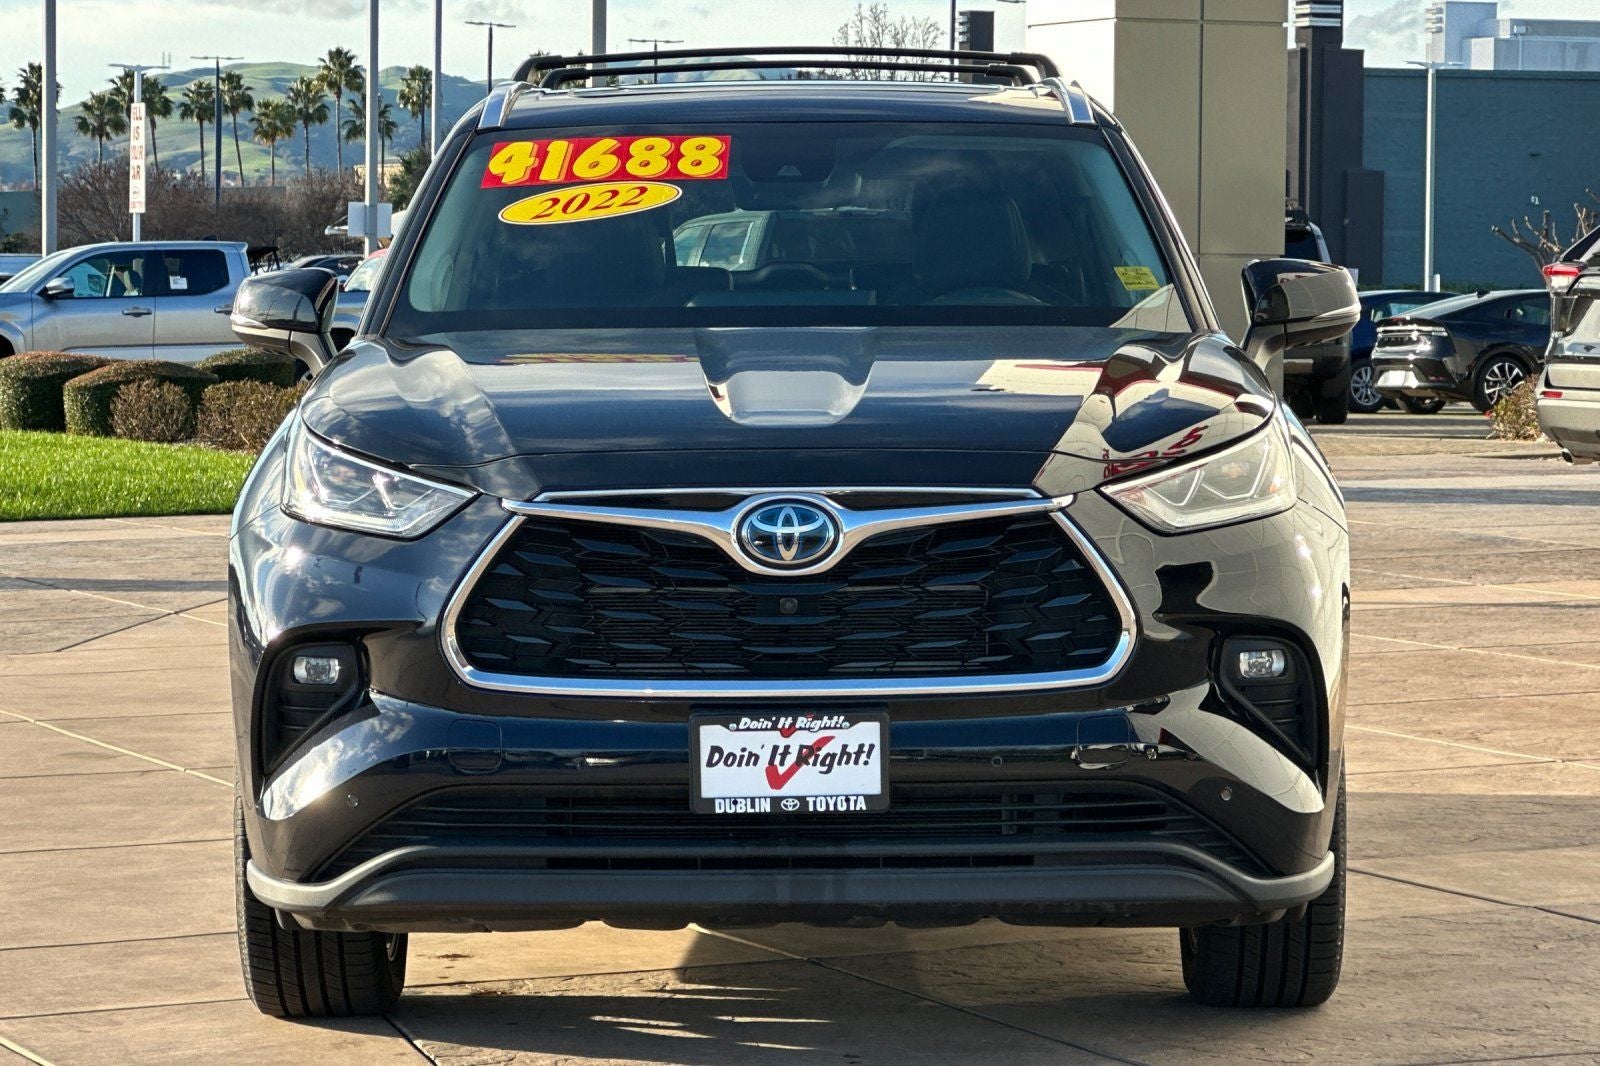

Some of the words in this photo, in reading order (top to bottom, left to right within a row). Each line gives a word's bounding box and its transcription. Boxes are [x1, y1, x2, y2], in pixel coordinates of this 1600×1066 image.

[488, 136, 726, 184] 41688
[530, 186, 649, 220] 2022
[738, 716, 775, 730] Doin'
[777, 716, 793, 729] It
[796, 715, 846, 732] Right!
[705, 744, 765, 768] Doin'
[768, 744, 792, 767] It
[795, 743, 876, 775] Right!
[714, 797, 771, 814] DUBLIN
[806, 796, 867, 812] TOYOTA
